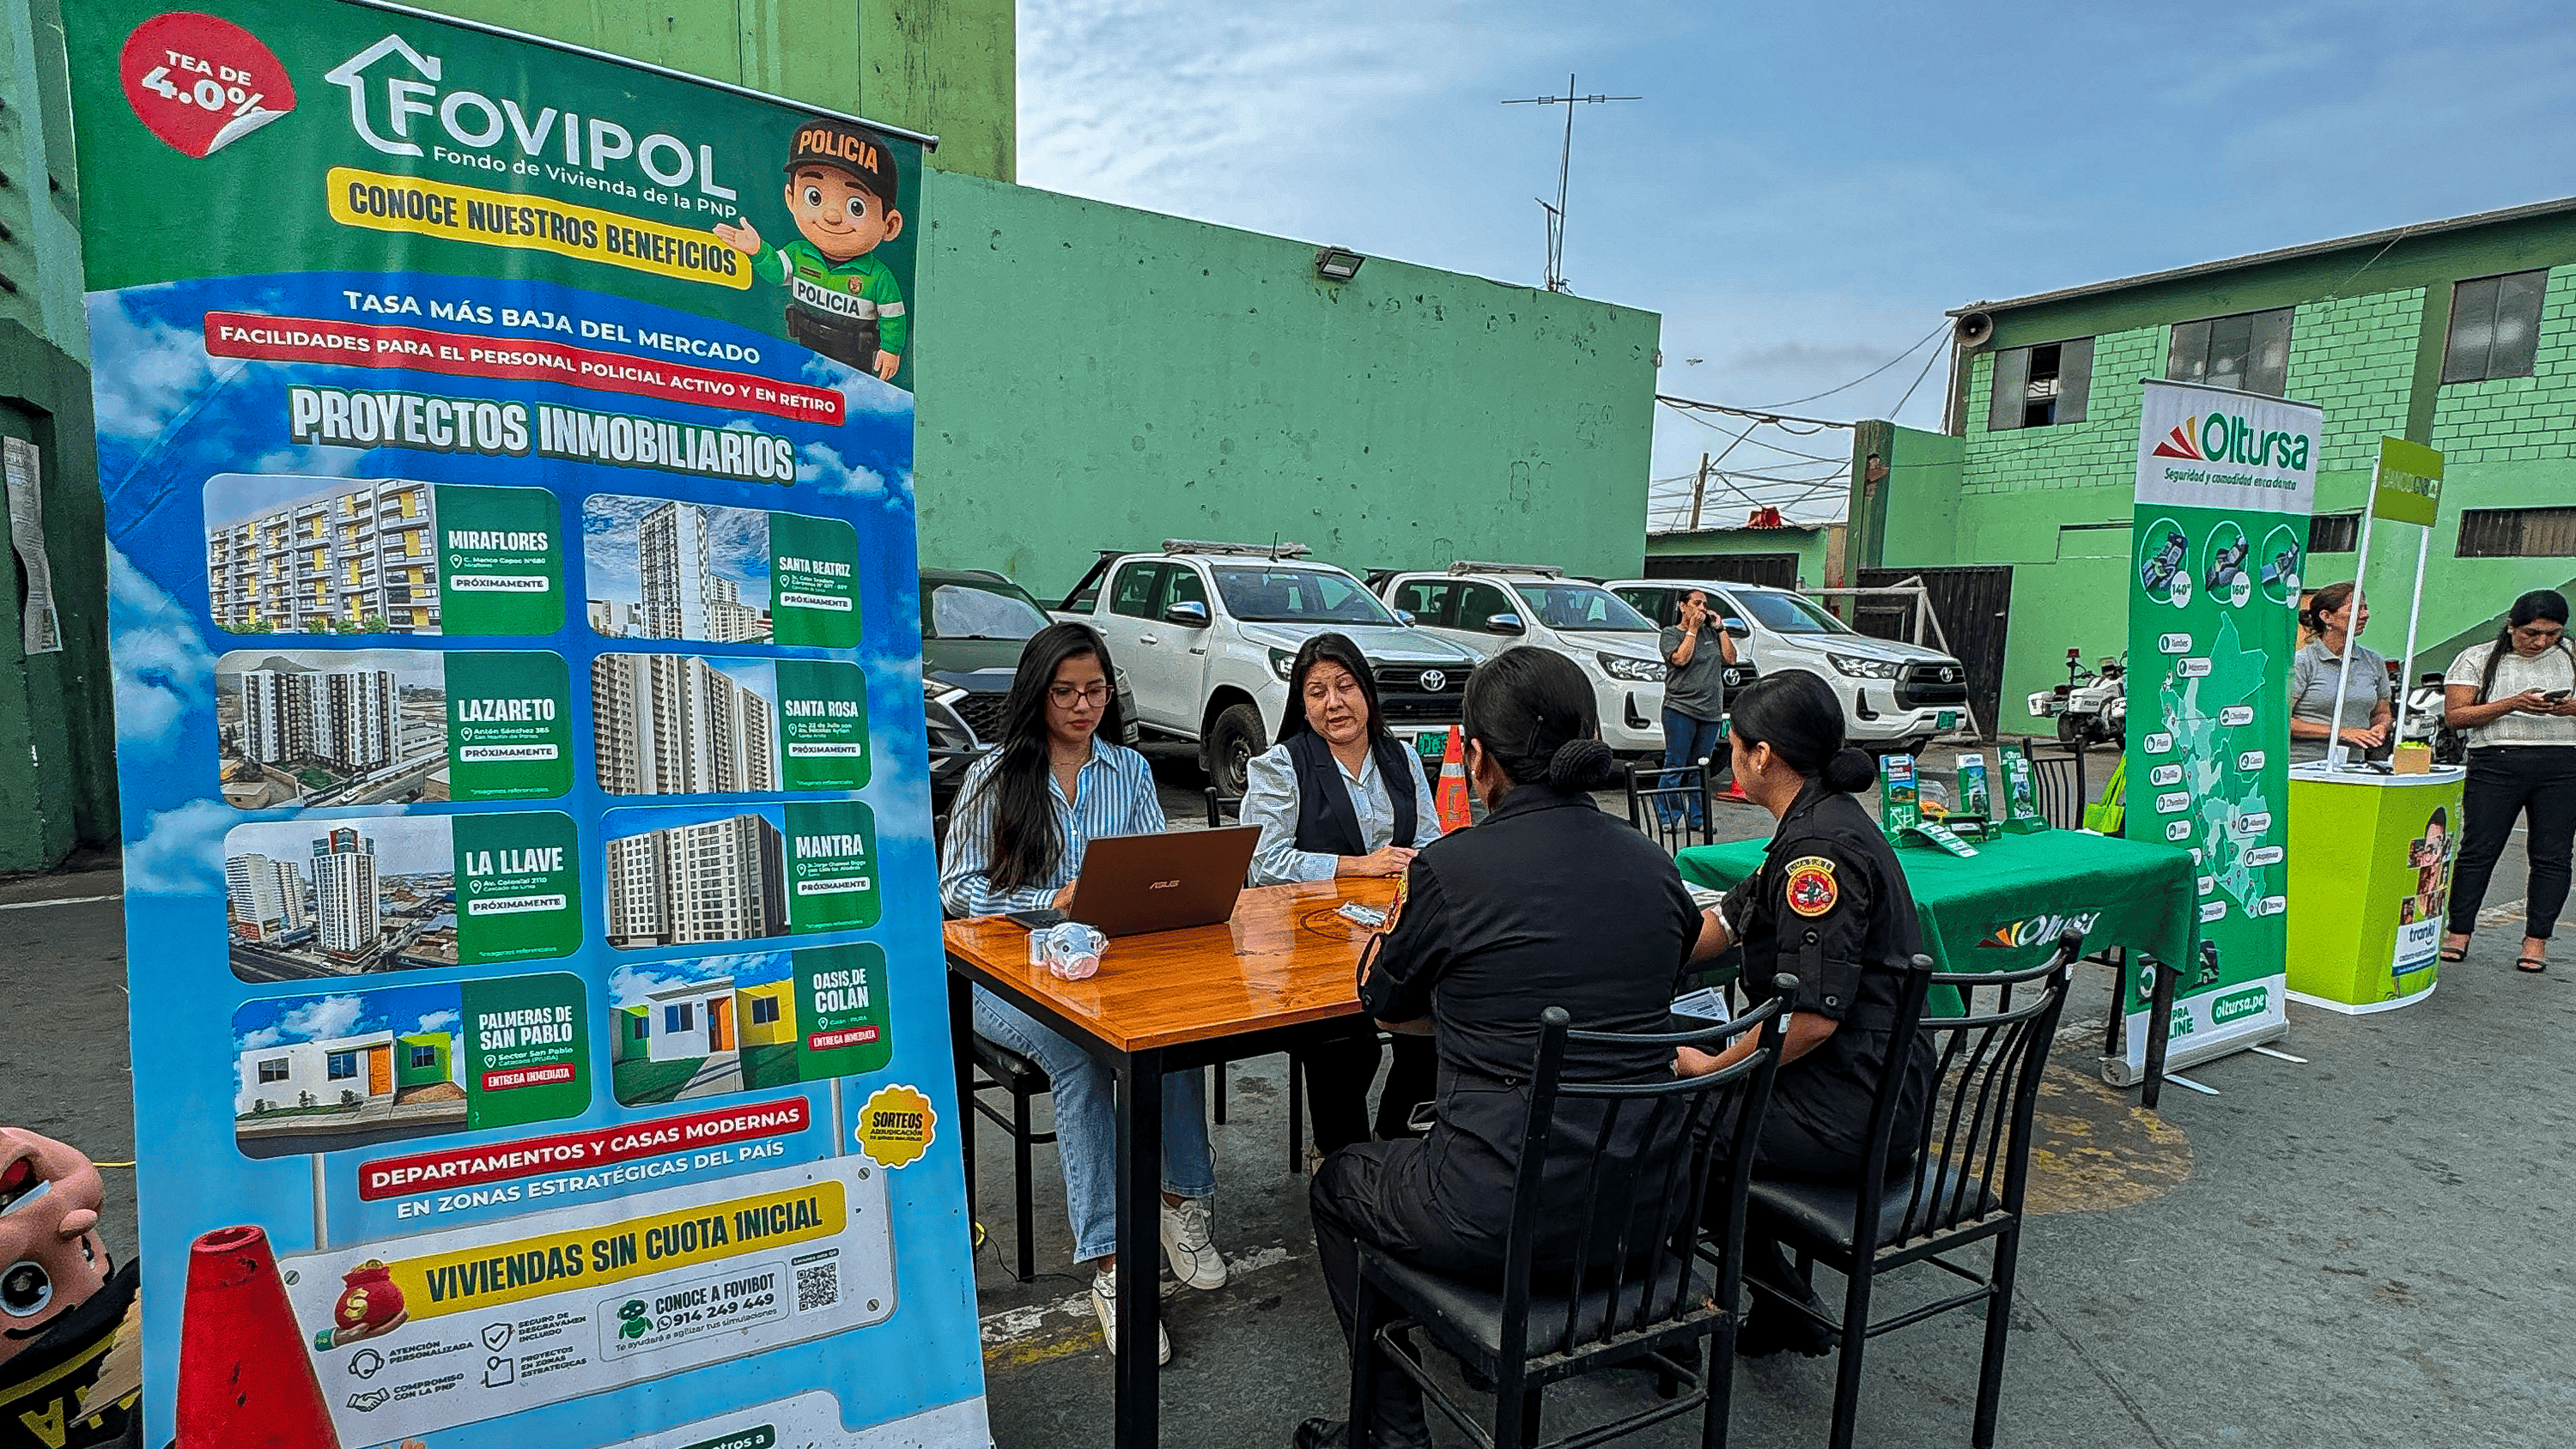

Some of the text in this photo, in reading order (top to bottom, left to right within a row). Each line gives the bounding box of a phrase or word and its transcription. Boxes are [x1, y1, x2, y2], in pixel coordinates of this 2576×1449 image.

[166, 50, 252, 87] TEA DE
[142, 66, 268, 116] 4.0%
[389, 77, 737, 201] FOVIPOL
[799, 129, 879, 174] POLICIA
[433, 146, 737, 220] Fondo de Vivienda de la PNP
[349, 182, 738, 276] CONOCE NUESTROS BENEFICIOS
[798, 282, 860, 316] POLICIA
[343, 290, 761, 364] TASA MÁS BAJA DEL MERCADO
[219, 326, 836, 415] FACILIDADES PARA EL PERSONAL POLICIAL ACTIVO Y EN RETIRO
[290, 386, 794, 482] PROYECTOS INMOBILIARIOS
[2202, 412, 2309, 472] Oltursa
[448, 530, 549, 551] MIRAFLORES
[779, 556, 852, 577] SANTA BEATRIZ
[456, 578, 544, 588] PRÓXIMAMENTE
[458, 699, 556, 722] LAZARETO
[785, 700, 859, 718] SANTA ROSA
[465, 748, 552, 758] PRÓXIMAMENTE
[792, 745, 857, 754] PRÓXIMAMENTE
[795, 834, 864, 858] MANTRA
[466, 846, 564, 876] LA LLAVE
[1149, 879, 1181, 889] ASUS
[473, 898, 561, 911] PRÓXIMAMENTE
[2409, 919, 2436, 943] tranki
[812, 967, 867, 991] OASIS DE
[815, 981, 870, 1014] COLÁN
[2215, 993, 2265, 1019] oltursa.pe
[478, 1005, 573, 1031] PALMERAS DE
[480, 1022, 573, 1051] SAN PABLO
[498, 1052, 528, 1061] Sector
[488, 1072, 526, 1088] ENTREGA
[872, 1111, 923, 1130] SORTEOS
[371, 1108, 800, 1189] DEPARTAMENTOS Y CASAS MODERNAS
[397, 1140, 785, 1220] EN ZONAS ESTRATÉGICAS DEL PAÍS
[425, 1196, 823, 1304] VIVIENDAS SIN CUOTA INICIAL
[655, 1272, 775, 1315] CONOCE A FOVIBOT
[518, 1314, 556, 1329] SEGURO
[672, 1293, 775, 1327] 914 249 449
[389, 1340, 440, 1357] ATENCIÓN
[616, 1343, 626, 1353] Te
[707, 1320, 721, 1331] tus
[389, 1341, 475, 1365] PERSONALIZADA
[520, 1345, 574, 1364] PROYECTOS
[520, 1354, 567, 1371] EN ZONAS
[393, 1373, 465, 1394] COMPROMISO
[393, 1381, 456, 1402] CON LA PNP
[756, 1434, 765, 1444] a
